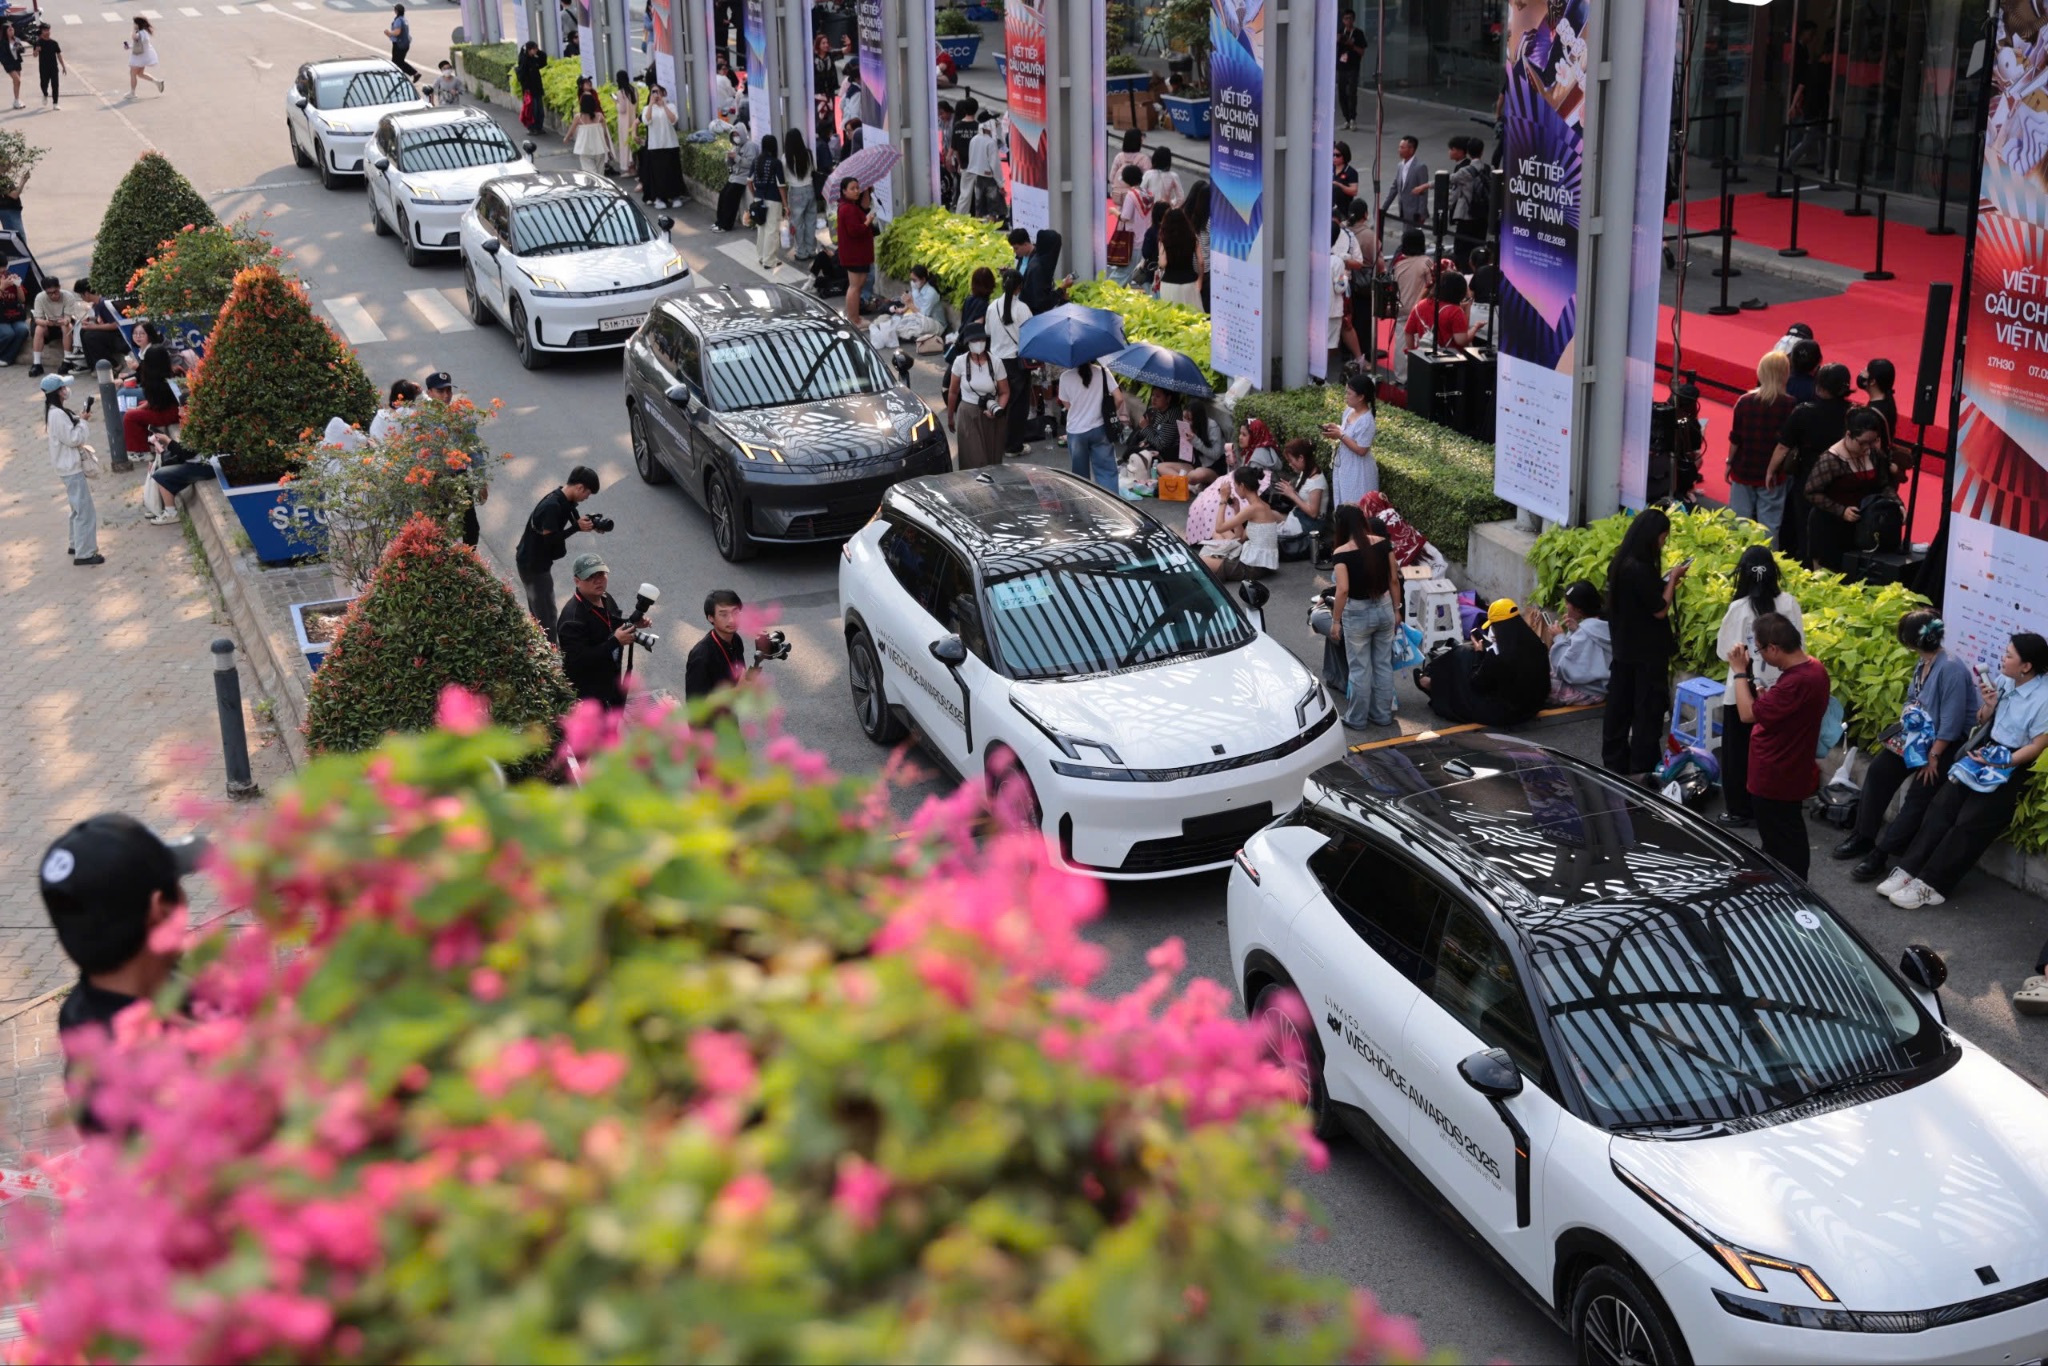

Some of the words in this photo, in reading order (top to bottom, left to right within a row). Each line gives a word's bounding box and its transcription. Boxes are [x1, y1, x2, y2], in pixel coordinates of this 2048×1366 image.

[1220, 86, 1235, 104] VIẾT
[1236, 89, 1252, 107] TIẾP
[1214, 103, 1229, 121] CÂU
[1229, 108, 1258, 129] CHUYỆN
[1219, 121, 1234, 142] VIỆT
[1235, 127, 1252, 143] NAM
[1518, 155, 1541, 177] VIẾT
[1543, 160, 1564, 182] TIẾP
[1509, 175, 1531, 197] CÂU
[1531, 182, 1573, 209] CHUYỆN
[1516, 199, 1539, 222] VIỆT
[1540, 205, 1563, 226] NAM
[1512, 226, 1530, 238] 17H30
[2002, 265, 2041, 295] VIẾT
[1984, 290, 2020, 319] CÂU
[1996, 321, 2034, 352] VIỆT
[1987, 356, 2015, 372] 17H30
[1801, 914, 1812, 924] 3
[1345, 1026, 1408, 1096] WECHOICE
[1408, 1085, 1464, 1147] AWARDS
[1464, 1135, 1500, 1179] 2025
